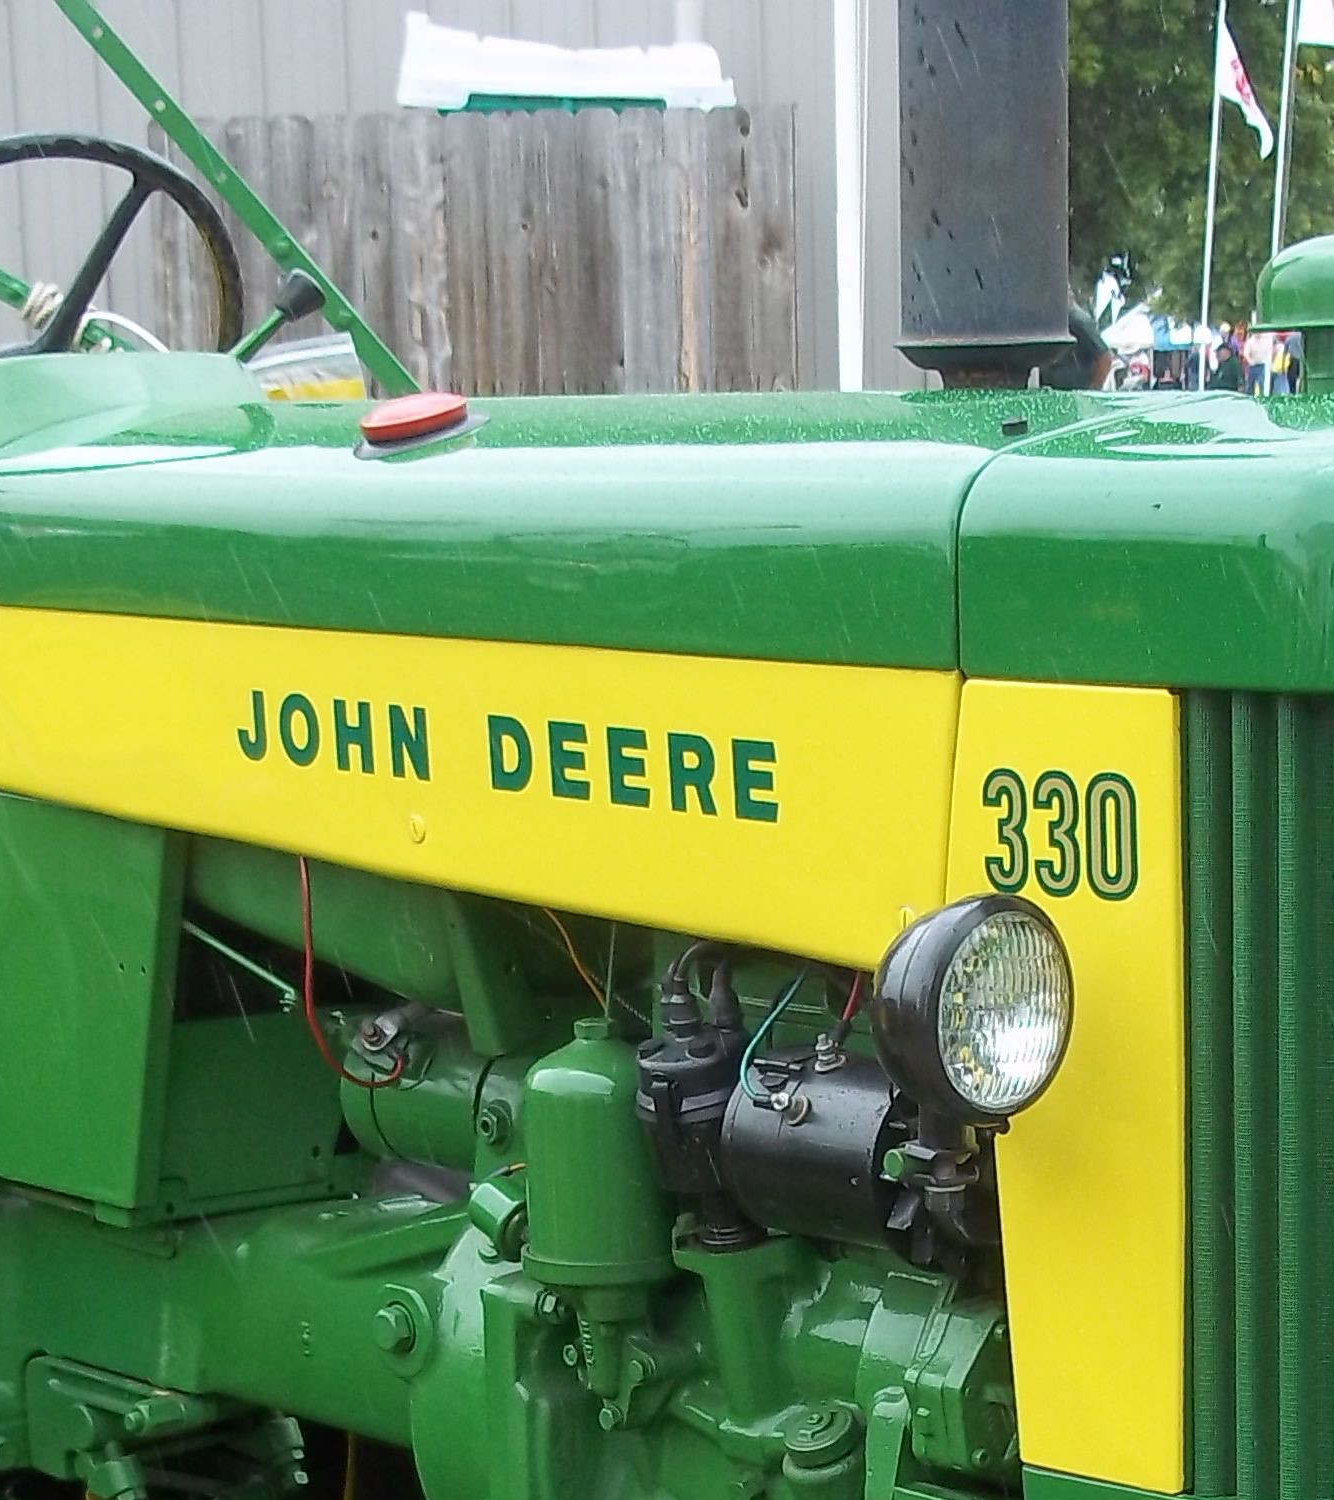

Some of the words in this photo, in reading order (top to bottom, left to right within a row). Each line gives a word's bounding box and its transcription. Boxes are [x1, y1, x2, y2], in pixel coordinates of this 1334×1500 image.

[237, 690, 432, 782] JOHN
[486, 713, 780, 824] DEERE
[982, 768, 1139, 901] 330
